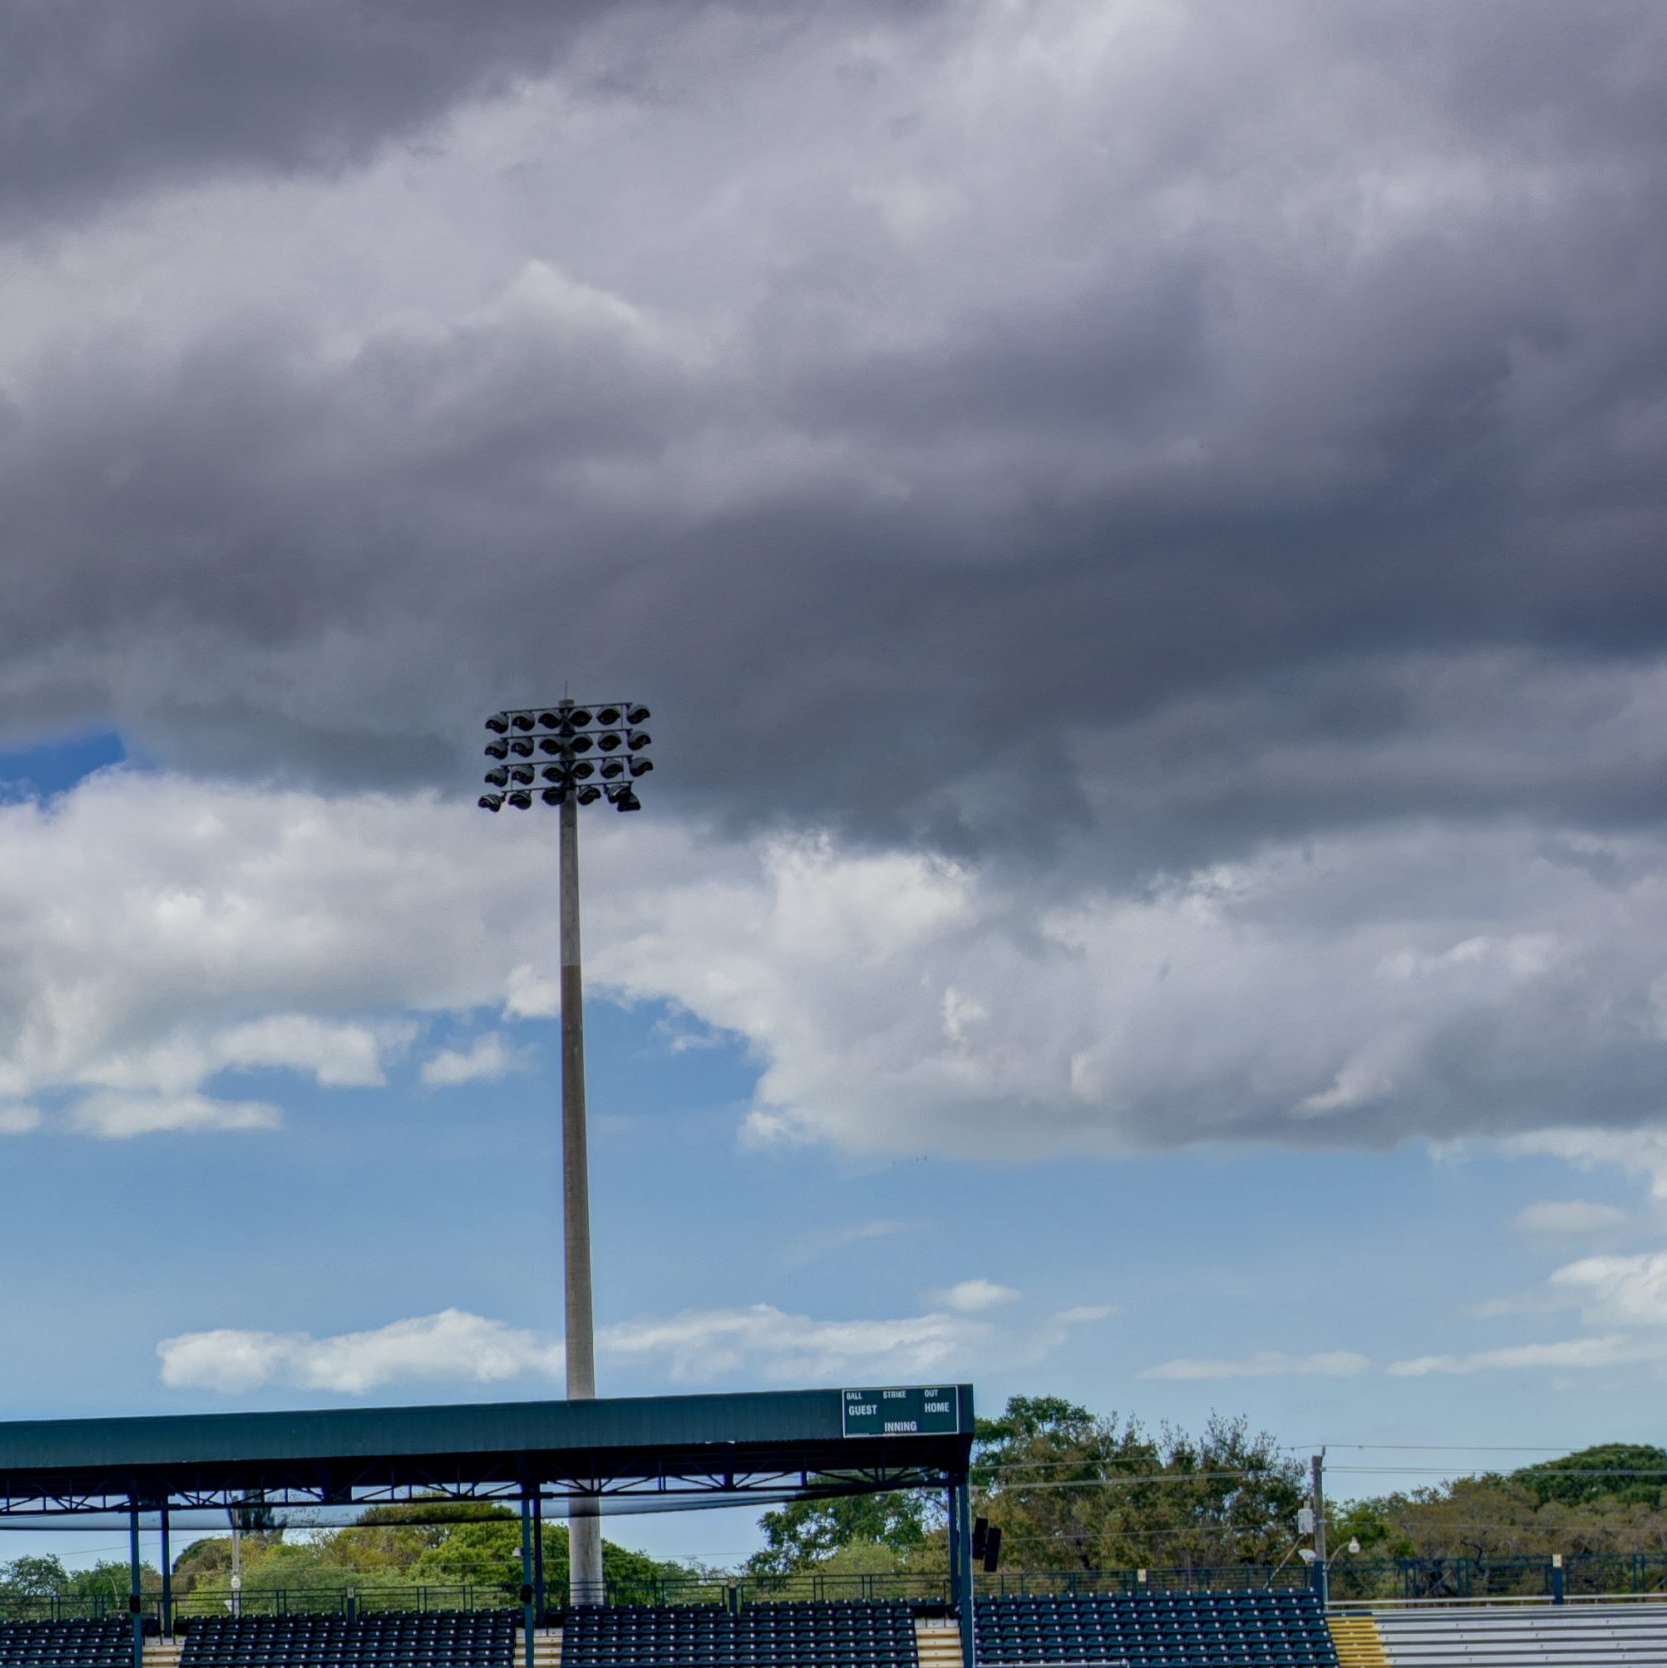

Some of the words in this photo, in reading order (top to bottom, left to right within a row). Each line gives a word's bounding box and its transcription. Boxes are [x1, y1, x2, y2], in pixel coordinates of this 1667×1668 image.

[846, 1392, 862, 1400] BALL
[882, 1391, 907, 1399] STRIKE
[924, 1389, 938, 1397] OUT
[848, 1404, 878, 1416] GUEST
[924, 1402, 950, 1413] HOME
[884, 1421, 917, 1432] INNING
